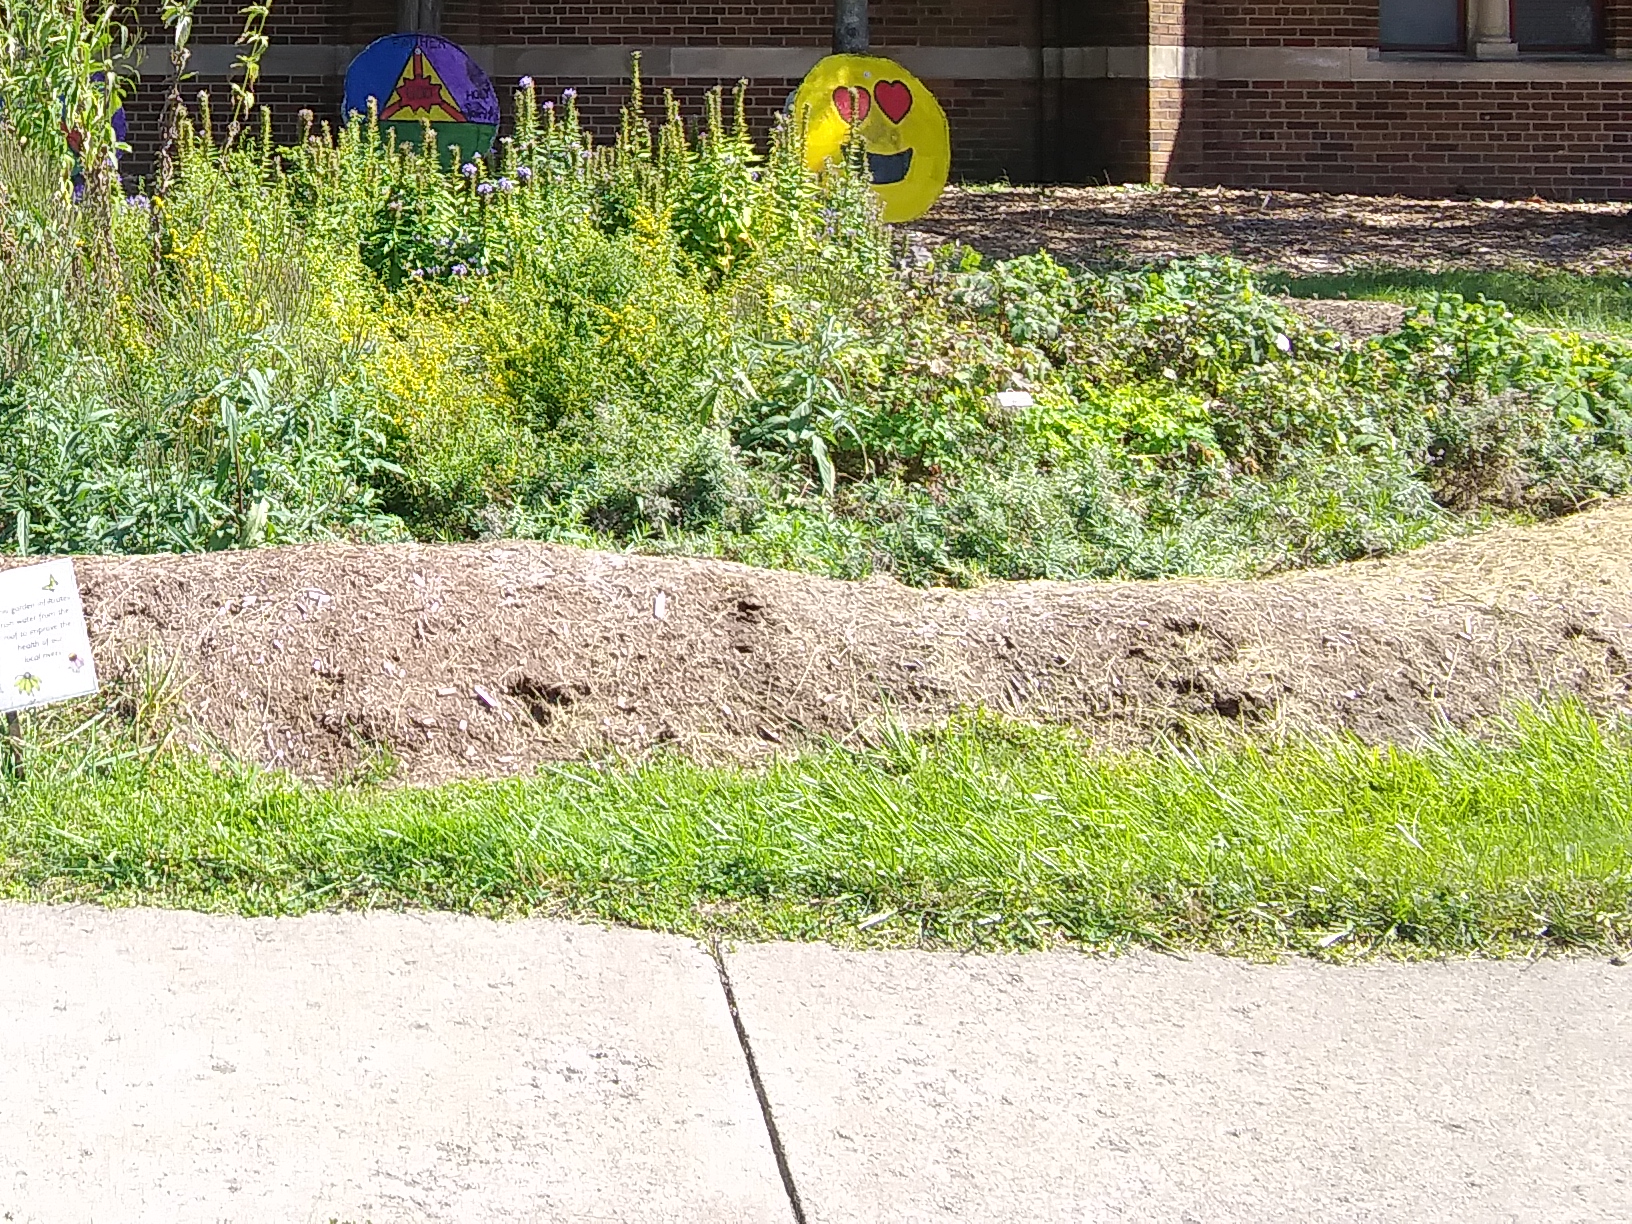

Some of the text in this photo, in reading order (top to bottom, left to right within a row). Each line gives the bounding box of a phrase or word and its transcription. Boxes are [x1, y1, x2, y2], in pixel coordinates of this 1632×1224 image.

[11, 603, 35, 616] garden
[58, 607, 69, 616] the
[60, 620, 71, 629] the
[24, 653, 41, 663] local
